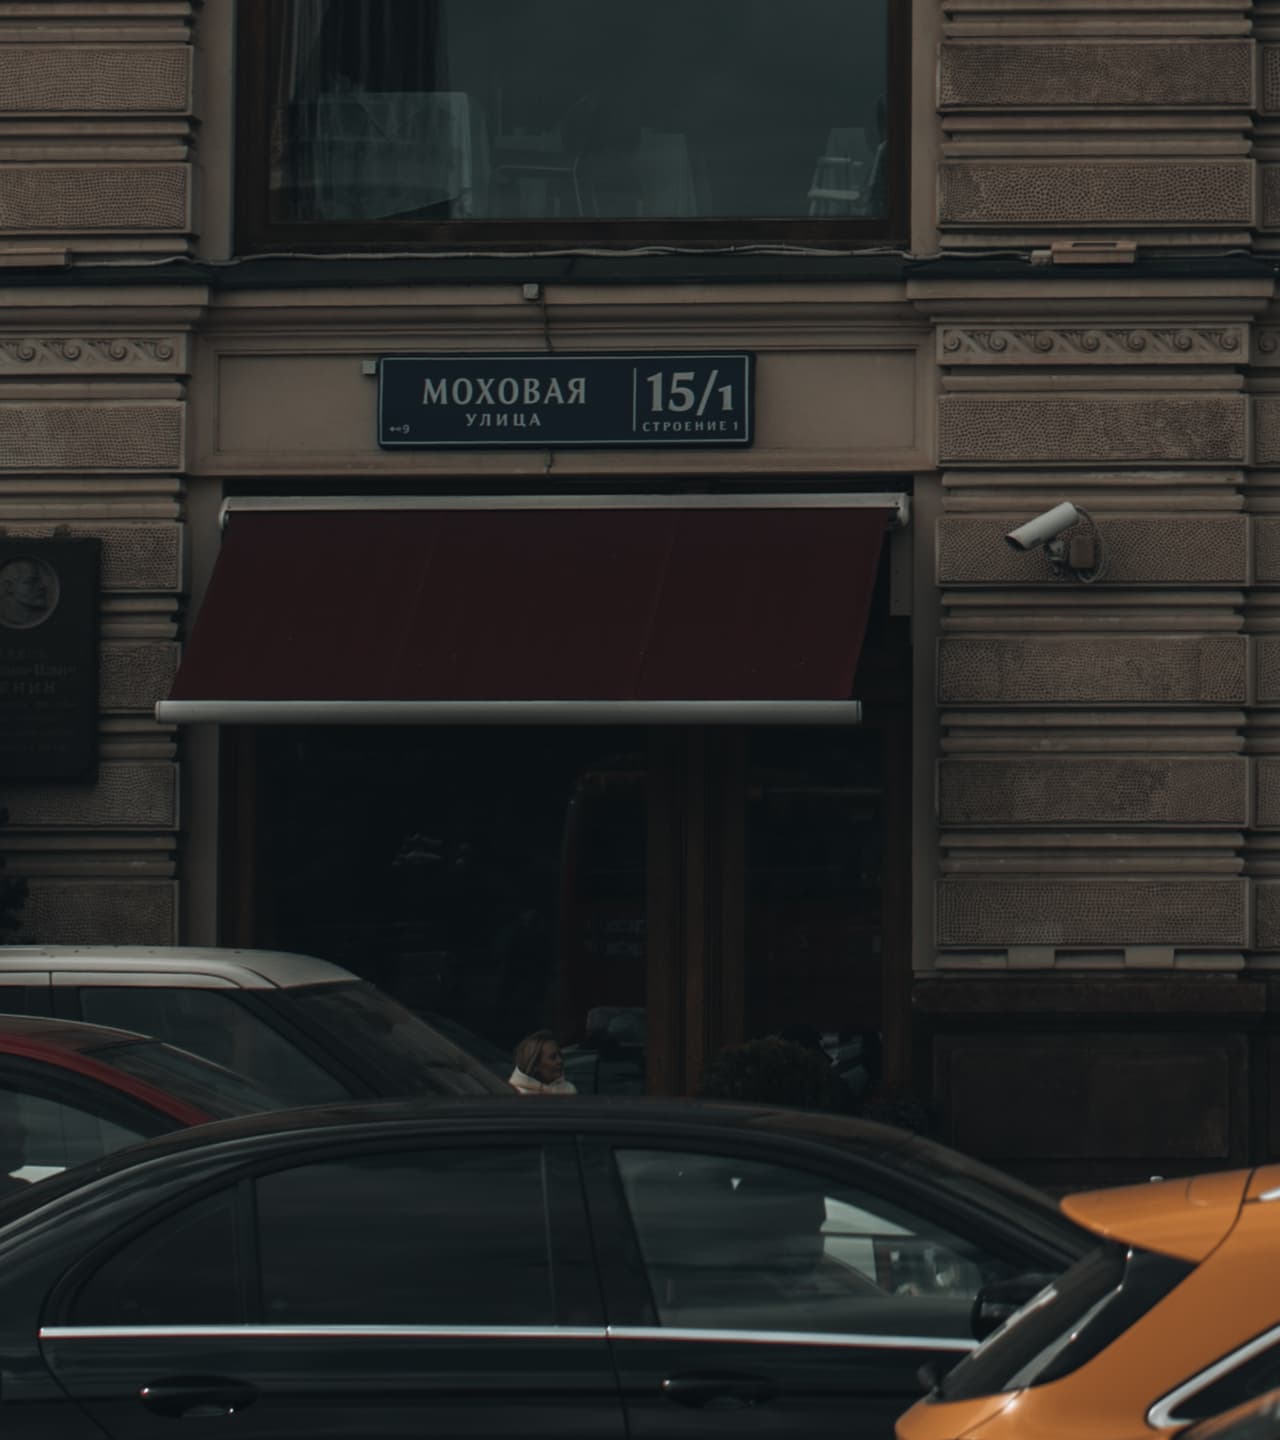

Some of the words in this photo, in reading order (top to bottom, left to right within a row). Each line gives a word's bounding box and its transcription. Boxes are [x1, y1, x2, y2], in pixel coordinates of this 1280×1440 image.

[421, 376, 587, 405] МОХОВАЯ
[645, 369, 734, 417] 15/1
[465, 412, 542, 428] УЛИЦА
[641, 420, 728, 433] СТРОЕНИЕ
[733, 421, 739, 432] 1
